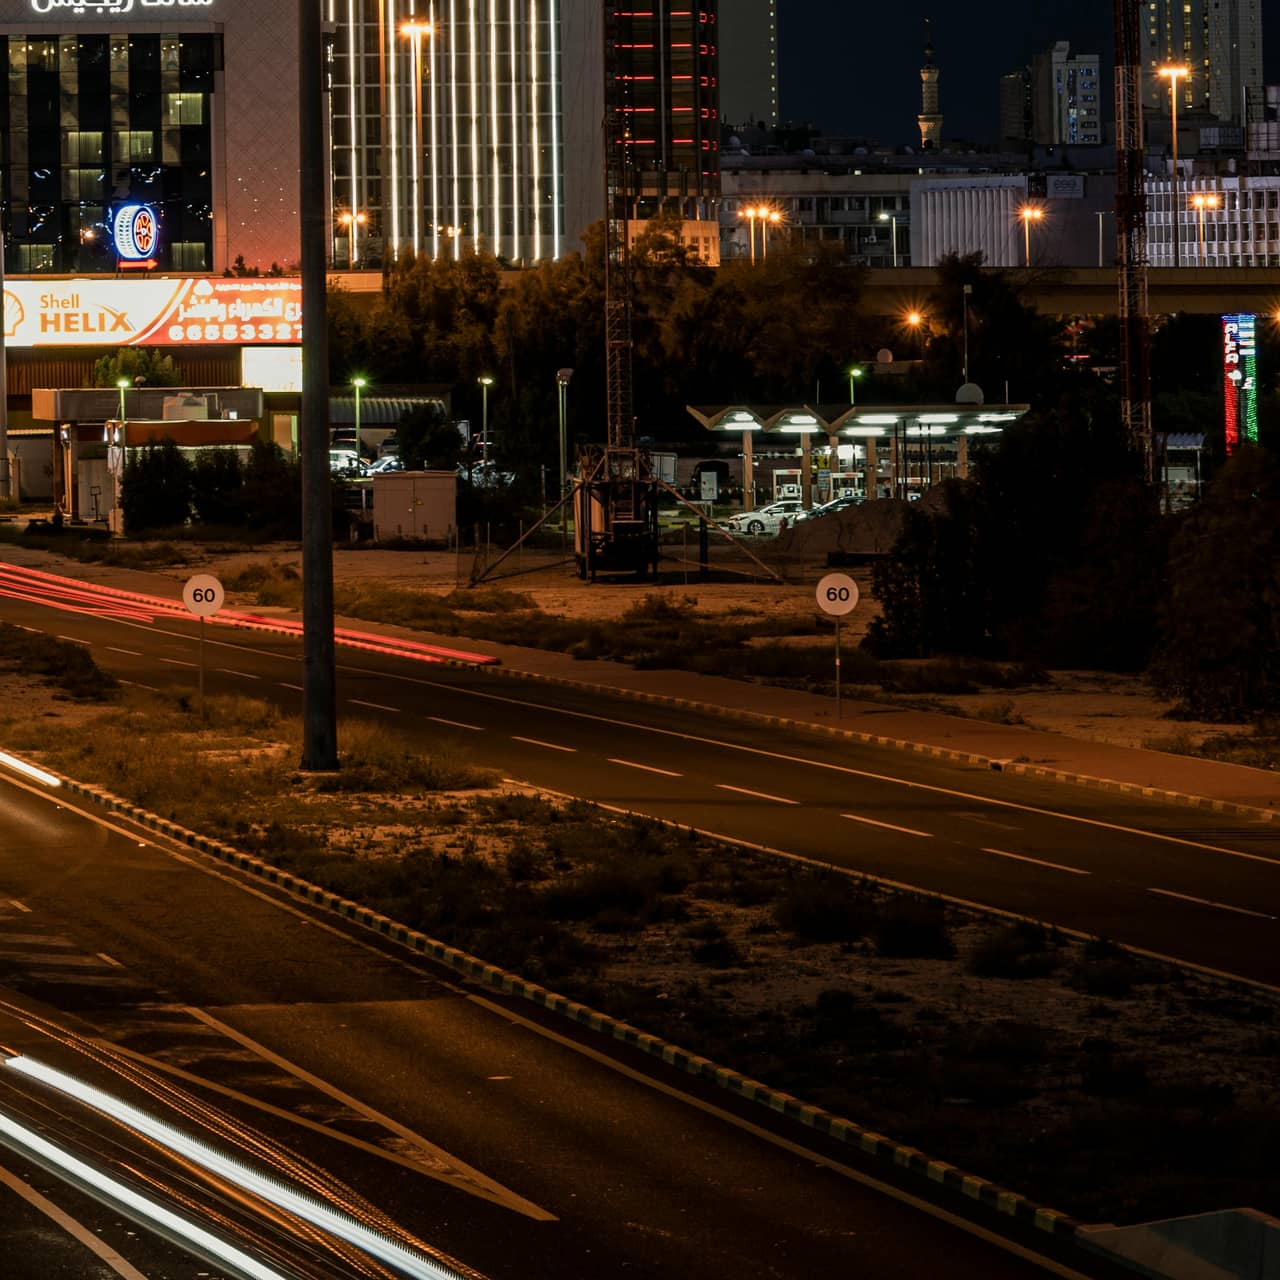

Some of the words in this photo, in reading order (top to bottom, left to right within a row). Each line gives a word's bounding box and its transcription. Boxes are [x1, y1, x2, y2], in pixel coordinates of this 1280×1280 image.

[40, 293, 80, 309] Shell
[40, 312, 134, 333] HELIX
[192, 587, 216, 603] 60
[826, 586, 850, 602] 60
